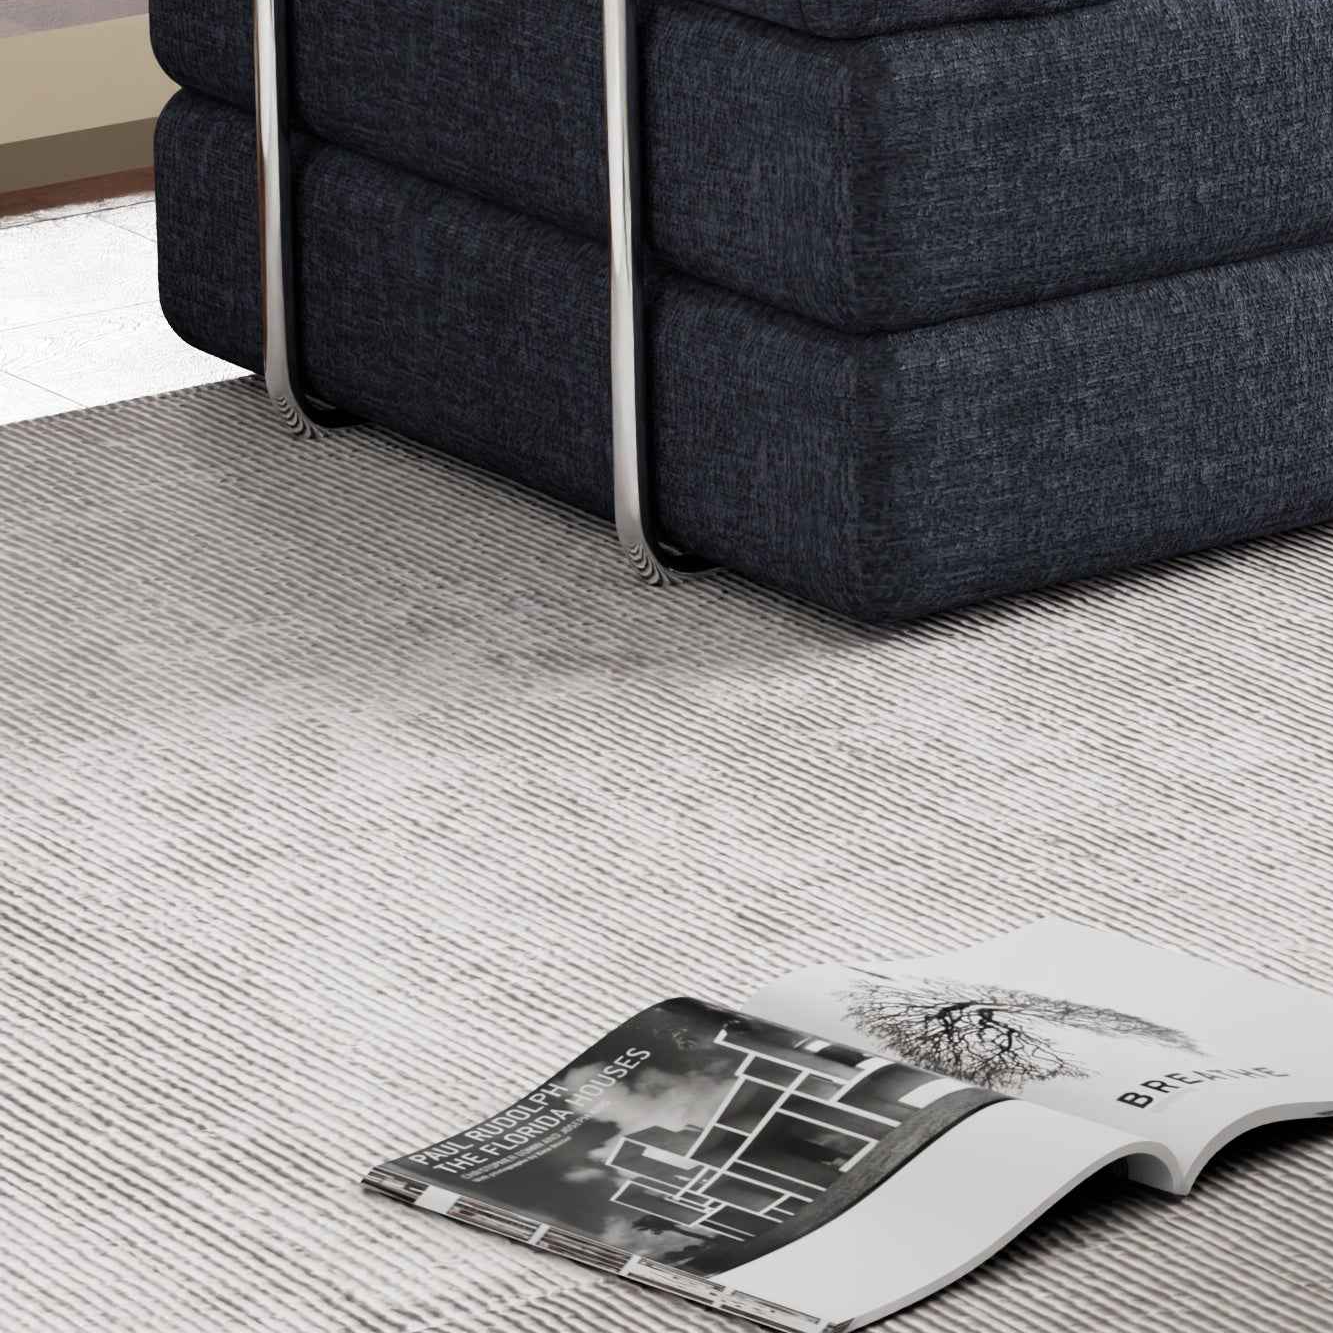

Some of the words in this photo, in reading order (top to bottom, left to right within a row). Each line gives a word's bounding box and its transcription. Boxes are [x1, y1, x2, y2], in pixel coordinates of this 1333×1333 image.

[410, 1137, 476, 1167] PAUL
[471, 1082, 569, 1141] RUDOLPH
[434, 1151, 489, 1174] THE
[488, 1108, 572, 1159] FLORIDA
[564, 1046, 651, 1108] HOUSES
[1116, 1065, 1291, 1110] BREATHE
